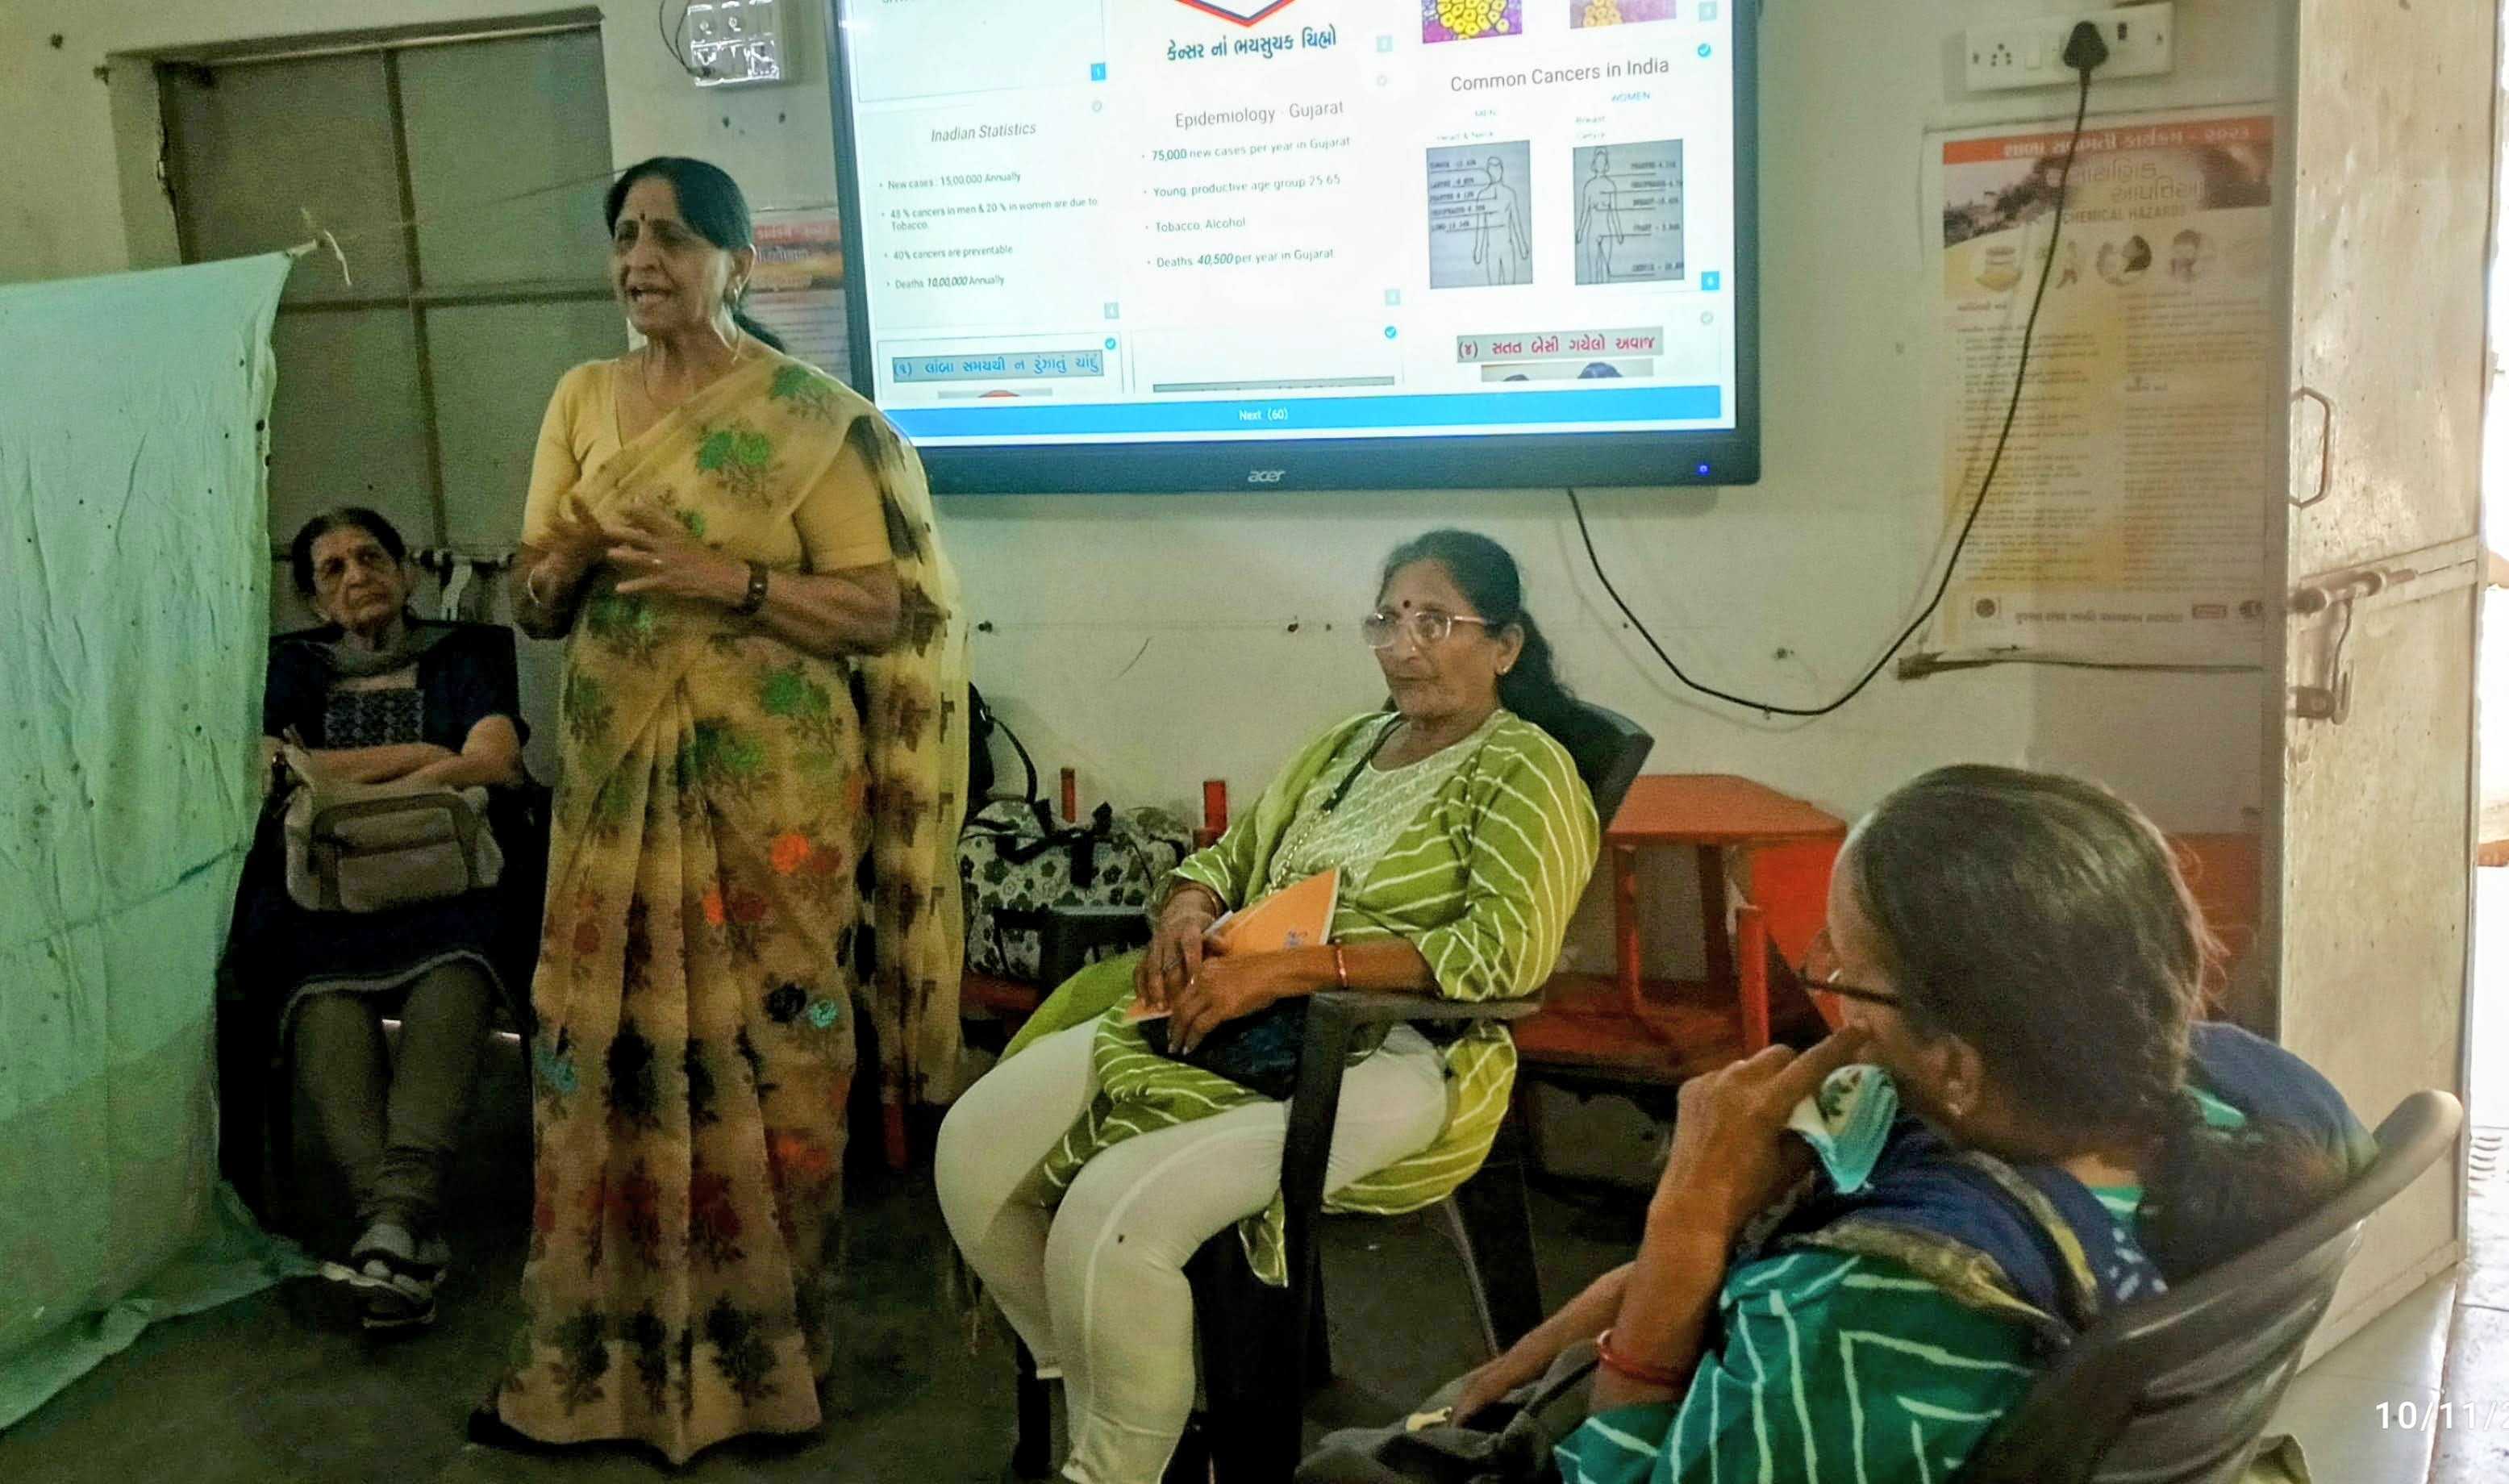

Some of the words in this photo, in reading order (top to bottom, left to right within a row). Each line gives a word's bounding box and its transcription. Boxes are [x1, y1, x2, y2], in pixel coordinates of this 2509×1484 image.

[1450, 73, 1527, 92] Common
[1531, 66, 1601, 85] Cancers
[1607, 61, 1621, 77] in
[1627, 57, 1669, 76] India
[1175, 106, 1276, 130] Epidemiology
[1289, 101, 1344, 121] Gujarat
[931, 126, 976, 142] Inadian
[978, 122, 1037, 140] Statistics
[1215, 147, 1246, 157] cases
[1310, 136, 1351, 151] Gujarat
[984, 171, 1021, 184] Annually
[1191, 181, 1248, 198] productive
[1273, 177, 1306, 192] group
[912, 206, 945, 218] cancers
[1019, 200, 1052, 211] women
[1205, 217, 1246, 230] Alcohol
[913, 249, 946, 260] cancers
[963, 244, 1014, 259] preventable
[1294, 248, 1335, 262] Gujarat
[969, 273, 1005, 287] Annually
[1491, 340, 1523, 355] સતત
[1531, 335, 1560, 353] બેસી
[1569, 333, 1606, 352] ગયેલો
[1615, 336, 1656, 350] અવાજ
[1239, 410, 1261, 421] Next
[1267, 407, 1288, 420] (60)
[1248, 471, 1286, 482] acer
